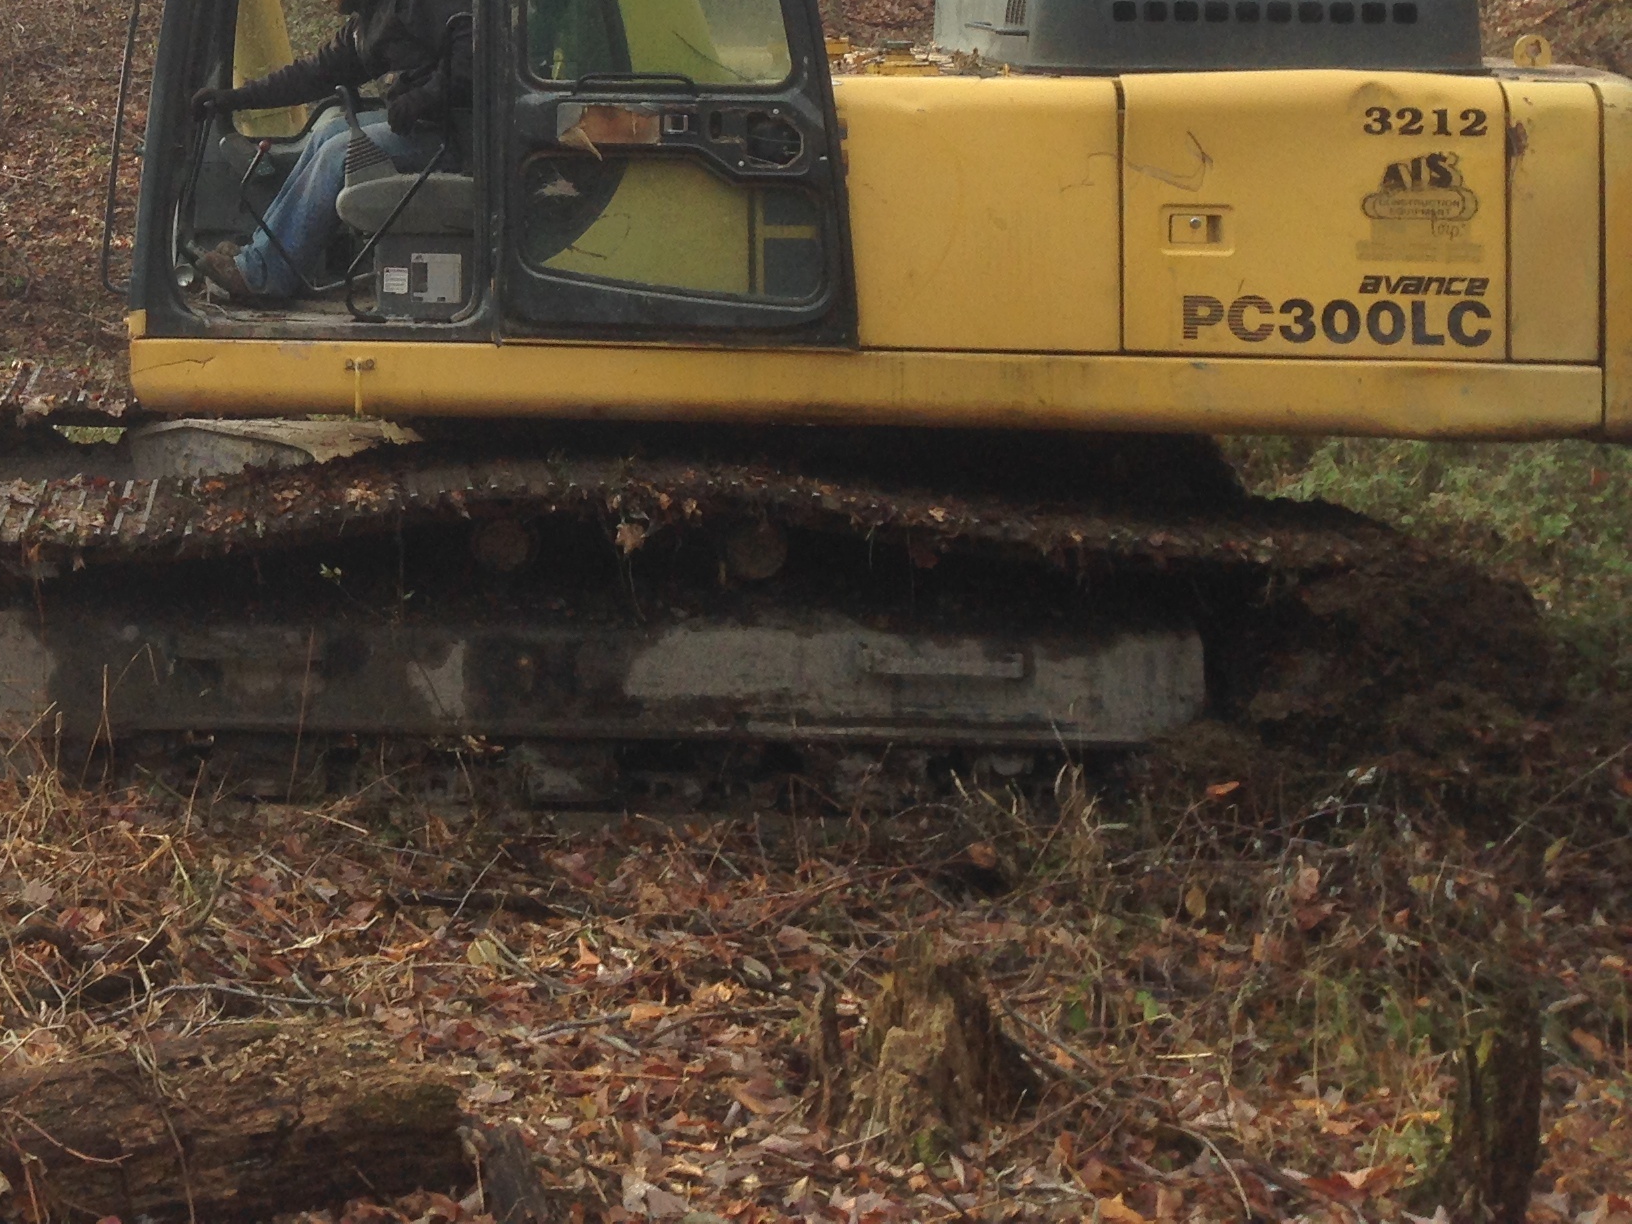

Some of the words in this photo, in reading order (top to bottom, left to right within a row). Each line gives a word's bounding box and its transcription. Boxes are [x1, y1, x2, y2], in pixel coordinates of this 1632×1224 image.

[1363, 107, 1488, 137] 3212
[1382, 152, 1456, 191] AIS
[1358, 275, 1490, 296] avance
[1182, 295, 1492, 348] PC300LC
